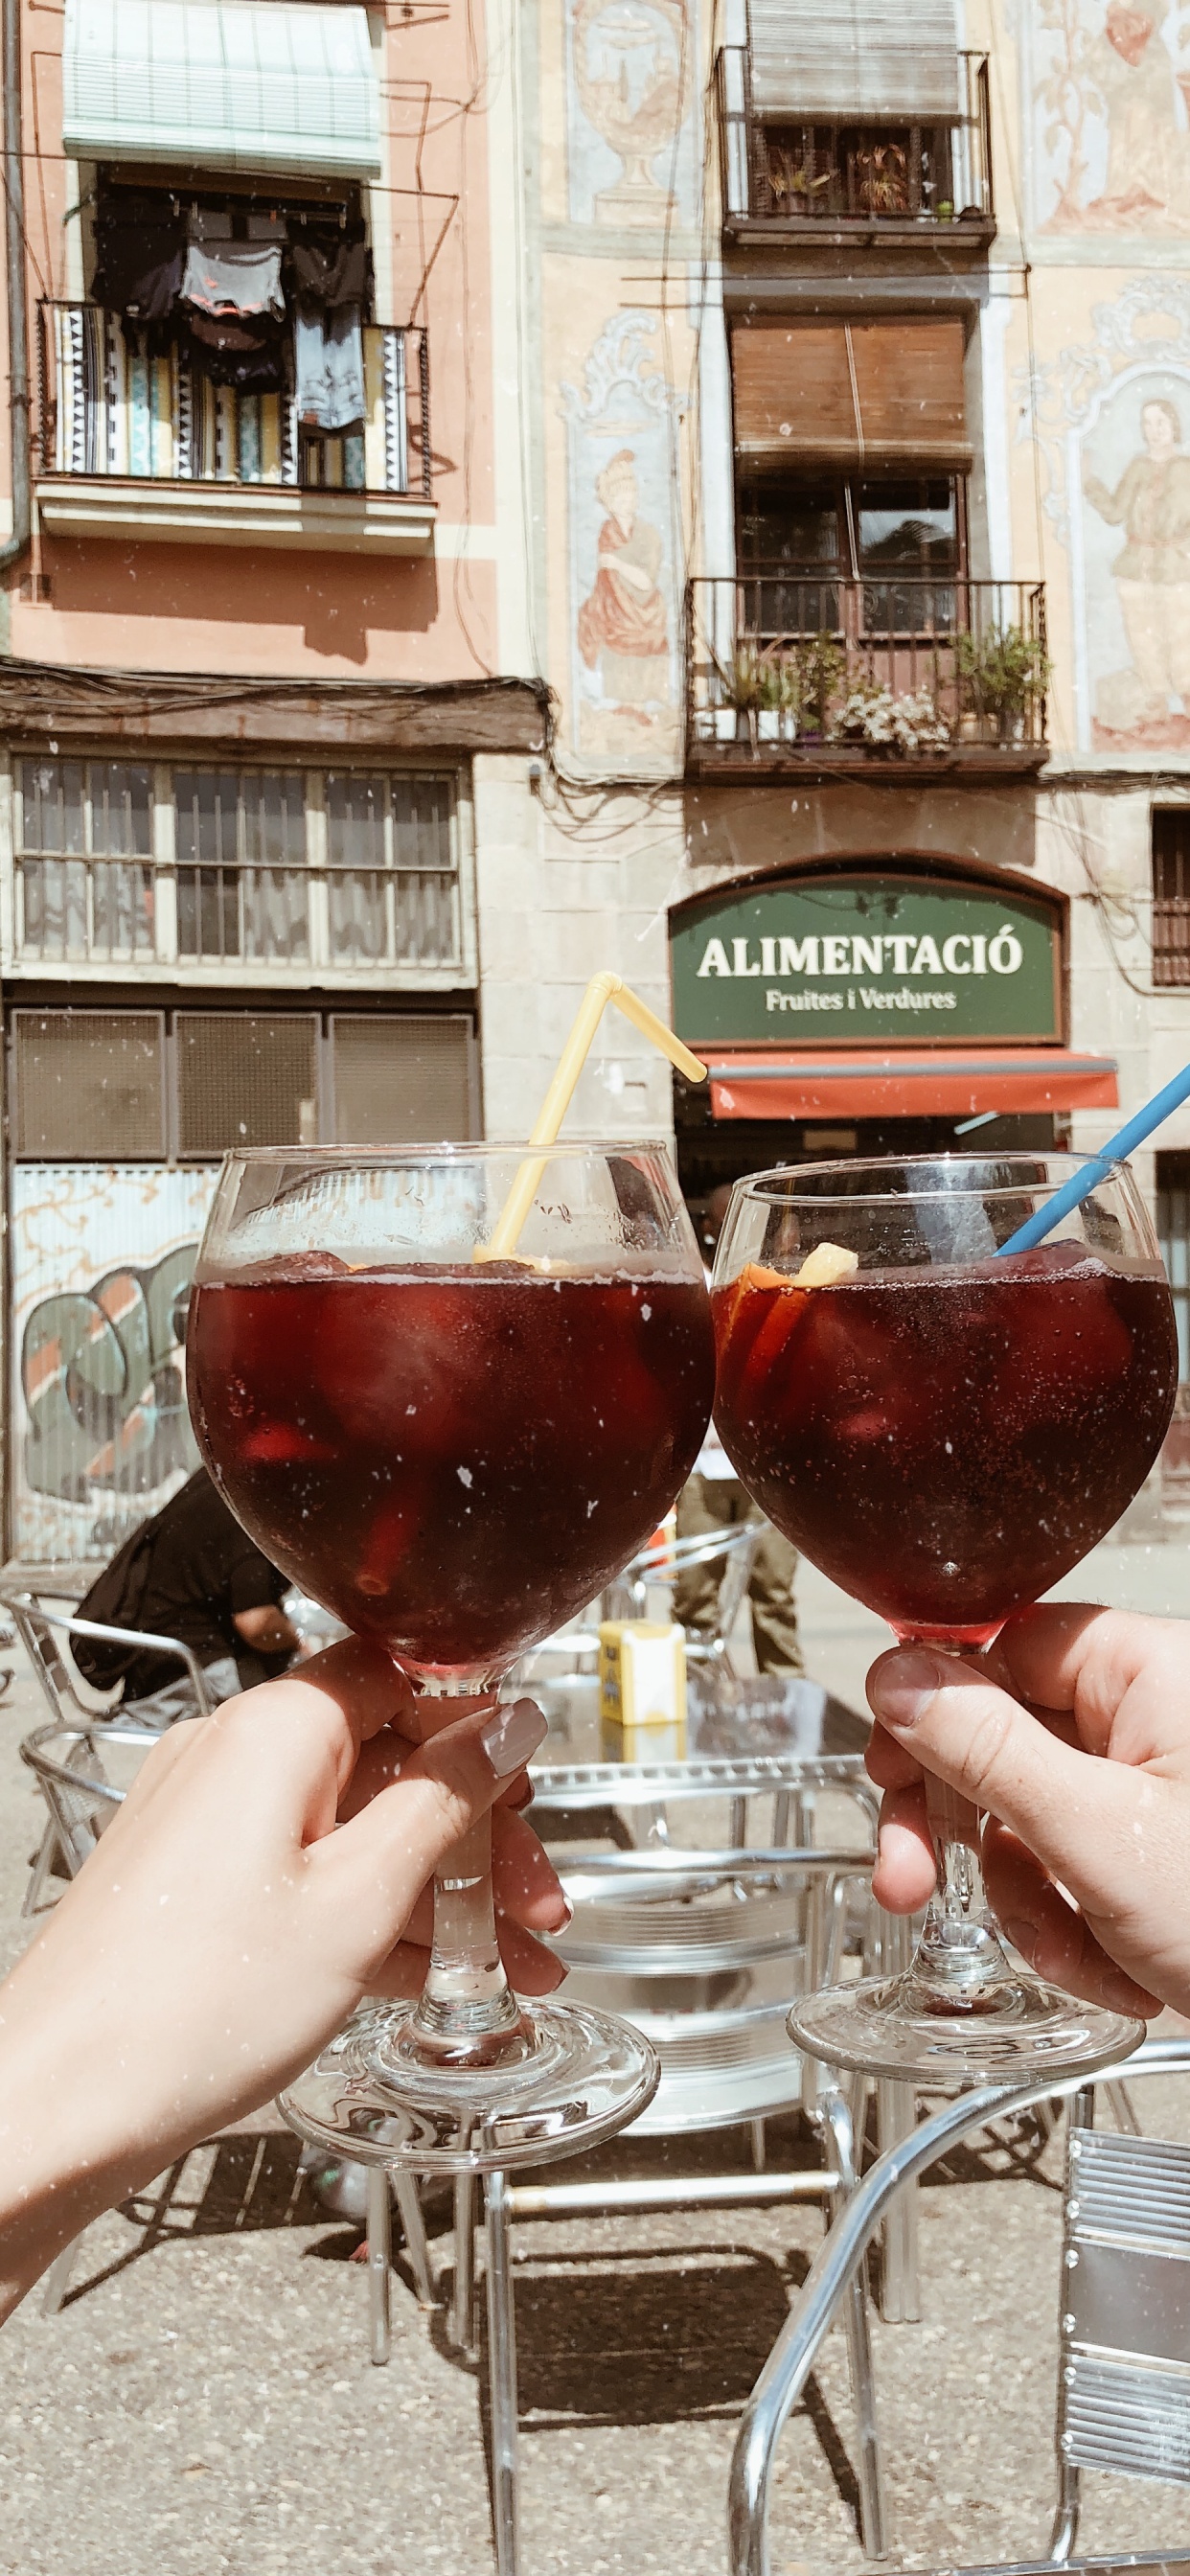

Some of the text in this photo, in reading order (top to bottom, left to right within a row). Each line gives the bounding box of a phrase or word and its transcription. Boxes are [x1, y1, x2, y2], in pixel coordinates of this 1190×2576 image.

[697, 924, 1022, 978] ALIMENTACIÓ
[766, 986, 957, 1012] Fruites i Verdures
